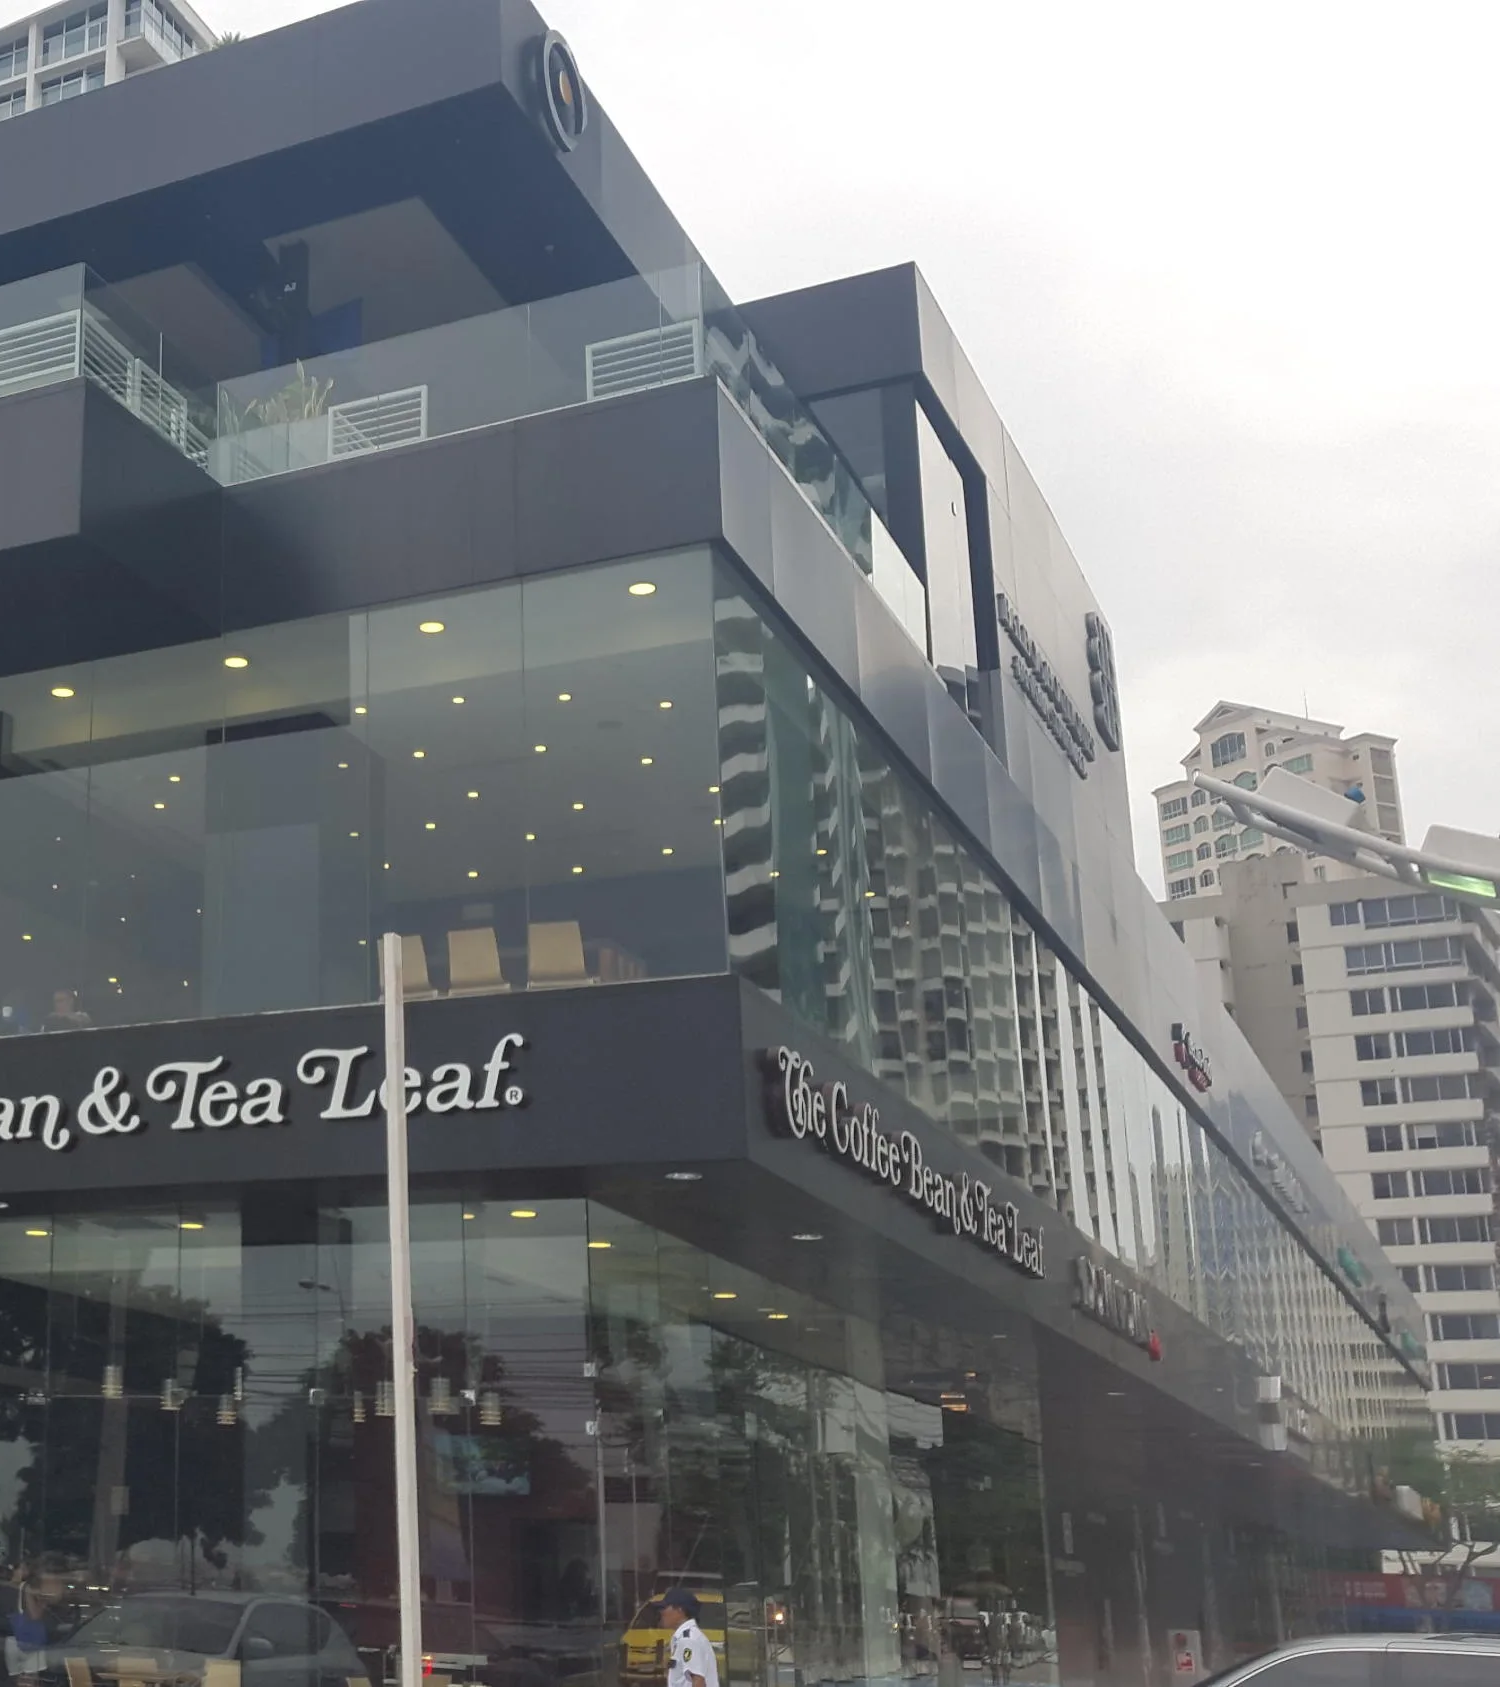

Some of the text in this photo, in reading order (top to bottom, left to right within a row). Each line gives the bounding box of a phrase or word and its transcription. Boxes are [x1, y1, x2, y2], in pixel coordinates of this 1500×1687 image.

[77, 1065, 140, 1135] &
[146, 1055, 285, 1131] Tea
[778, 1045, 1045, 1278] The Coffee Bean & Tea Leaf
